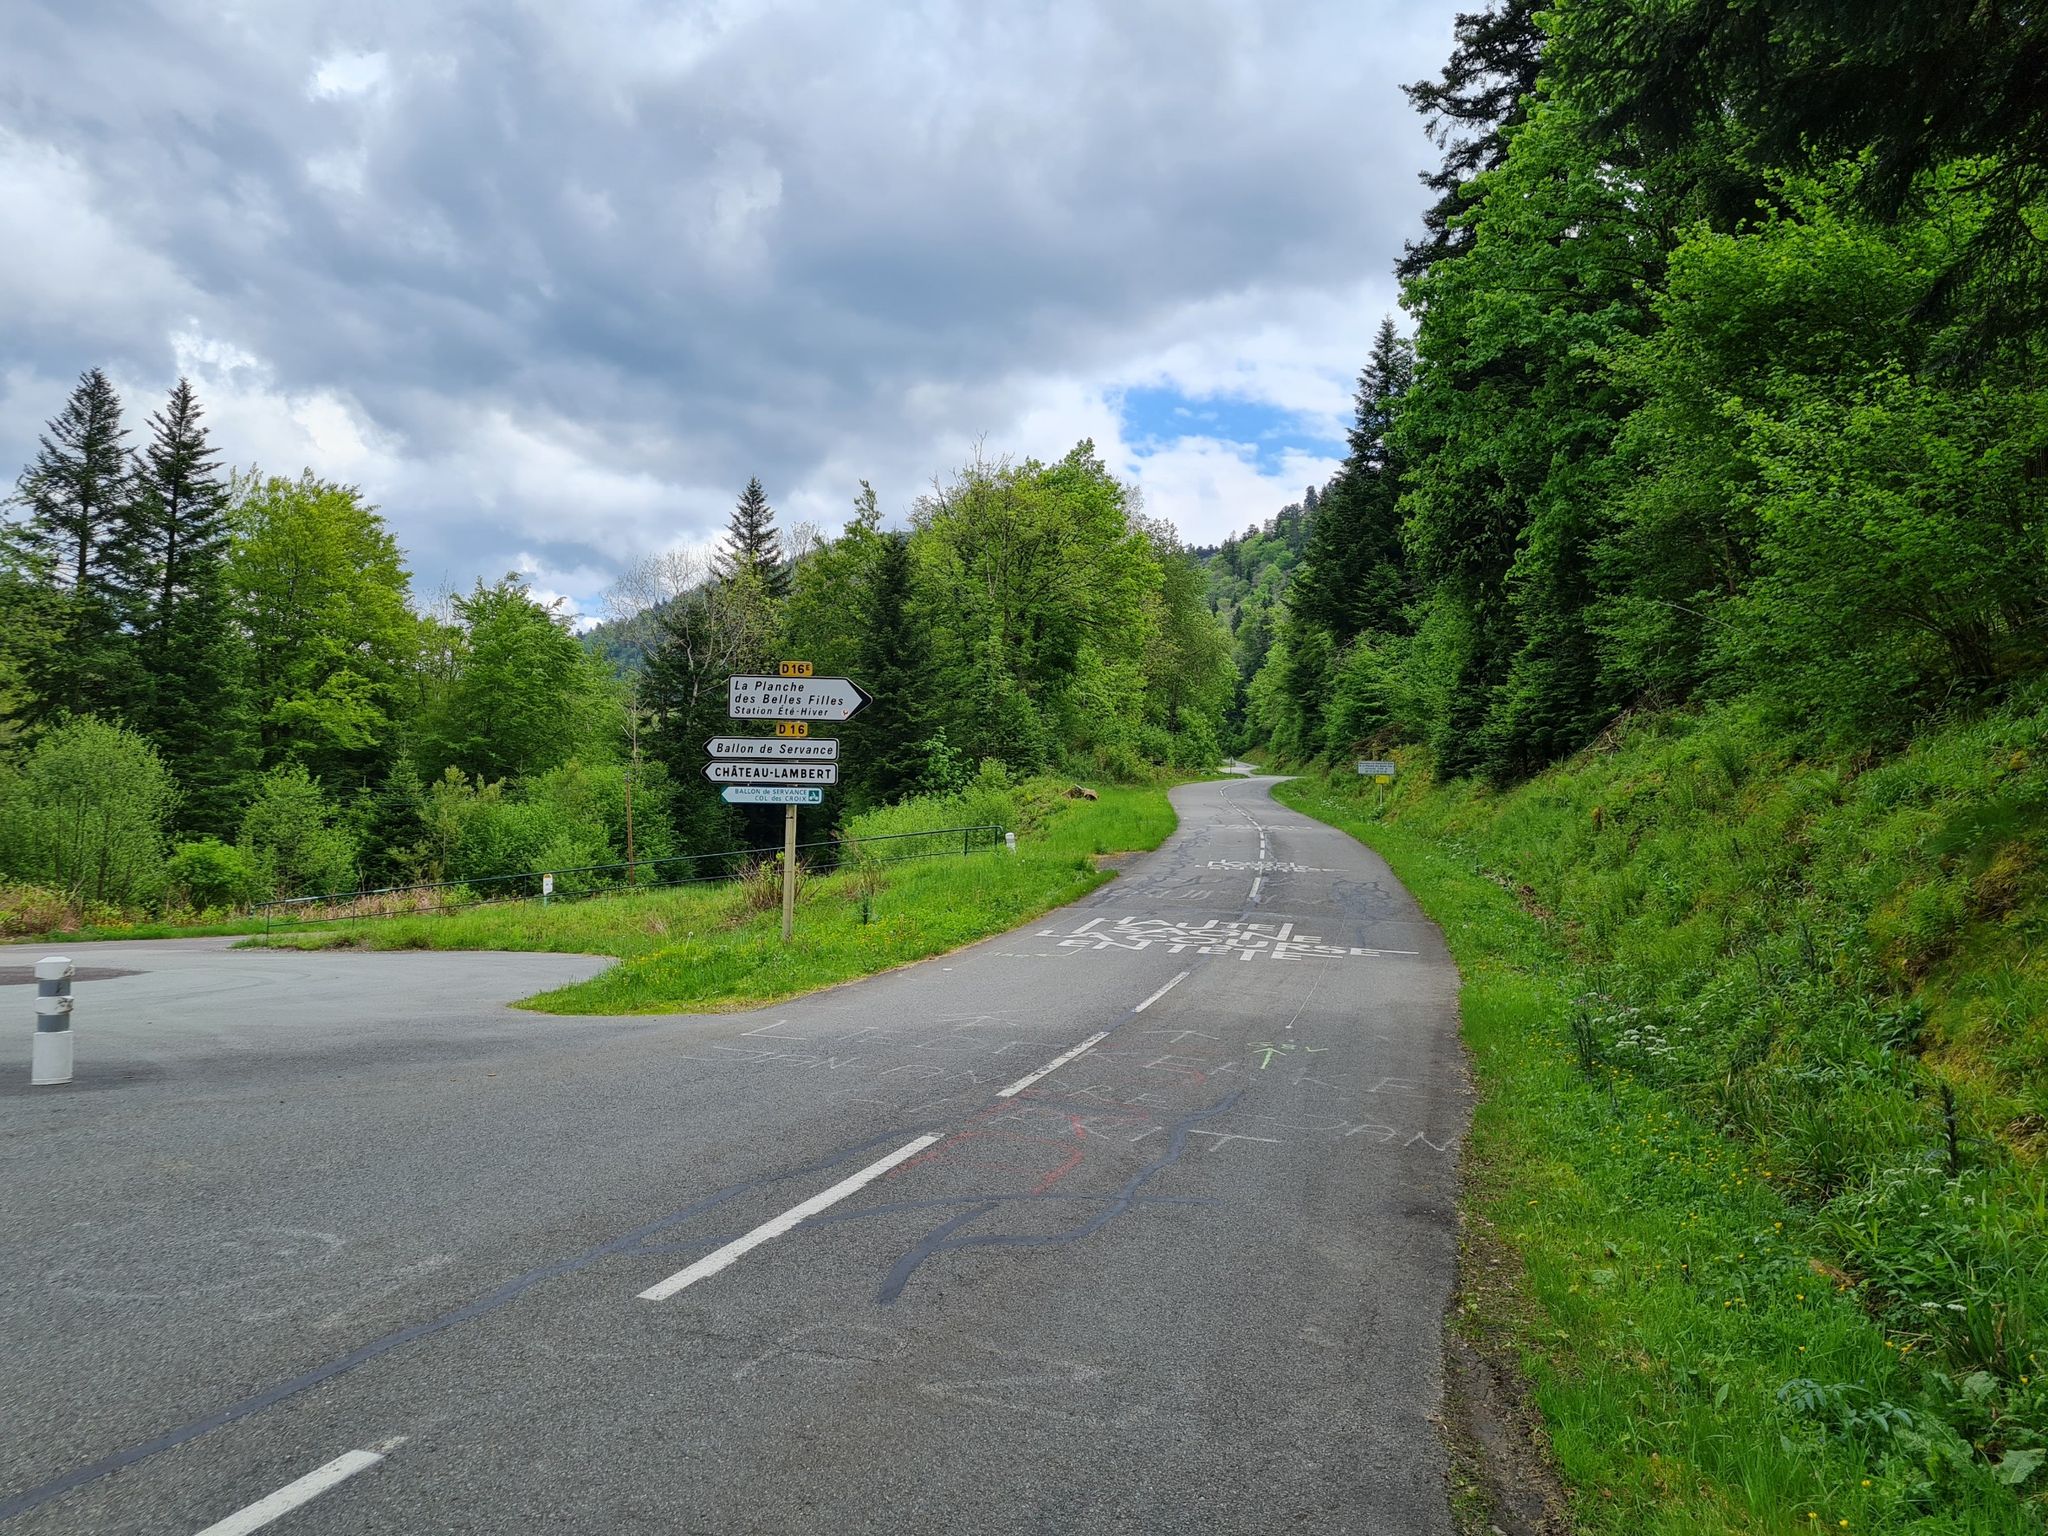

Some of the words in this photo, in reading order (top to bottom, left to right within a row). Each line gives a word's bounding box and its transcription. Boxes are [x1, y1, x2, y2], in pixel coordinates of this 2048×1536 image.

[734, 680, 748, 691] La
[754, 681, 805, 692] Planche
[734, 693, 756, 704] des
[762, 694, 802, 705] Belles
[808, 695, 844, 706] Filles
[734, 706, 773, 716] Station
[777, 704, 829, 717] Été-Hiver
[716, 742, 754, 754] Ballon
[759, 743, 773, 754] de
[779, 744, 834, 755] Servance
[714, 765, 832, 780] CHÂTEAU-LAMBERT
[1071, 916, 1276, 934] HAUTE
[1034, 930, 1115, 942] LA
[1125, 935, 1419, 957] COURSE
[1056, 939, 1154, 952] EN
